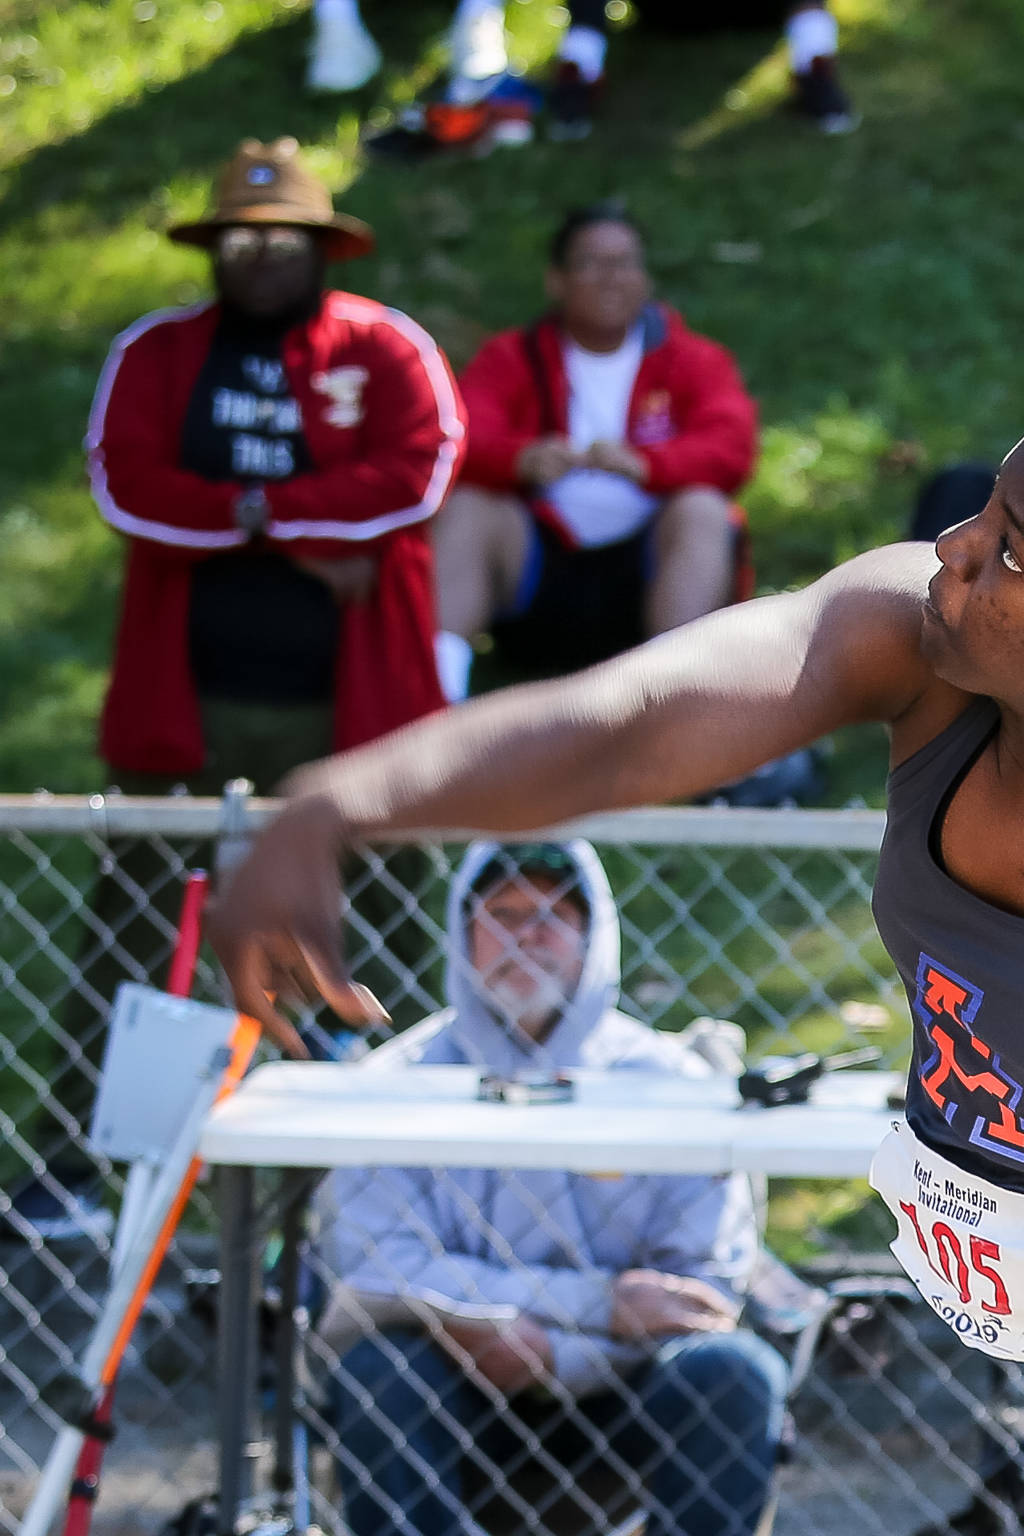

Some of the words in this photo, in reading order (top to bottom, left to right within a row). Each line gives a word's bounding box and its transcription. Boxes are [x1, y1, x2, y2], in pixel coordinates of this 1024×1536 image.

[914, 1160, 932, 1188] Kent
[945, 1179, 997, 1213] Meridian
[918, 1185, 982, 1227] Invitational
[900, 1200, 1012, 1315] 105
[942, 1306, 999, 1344] 2019
